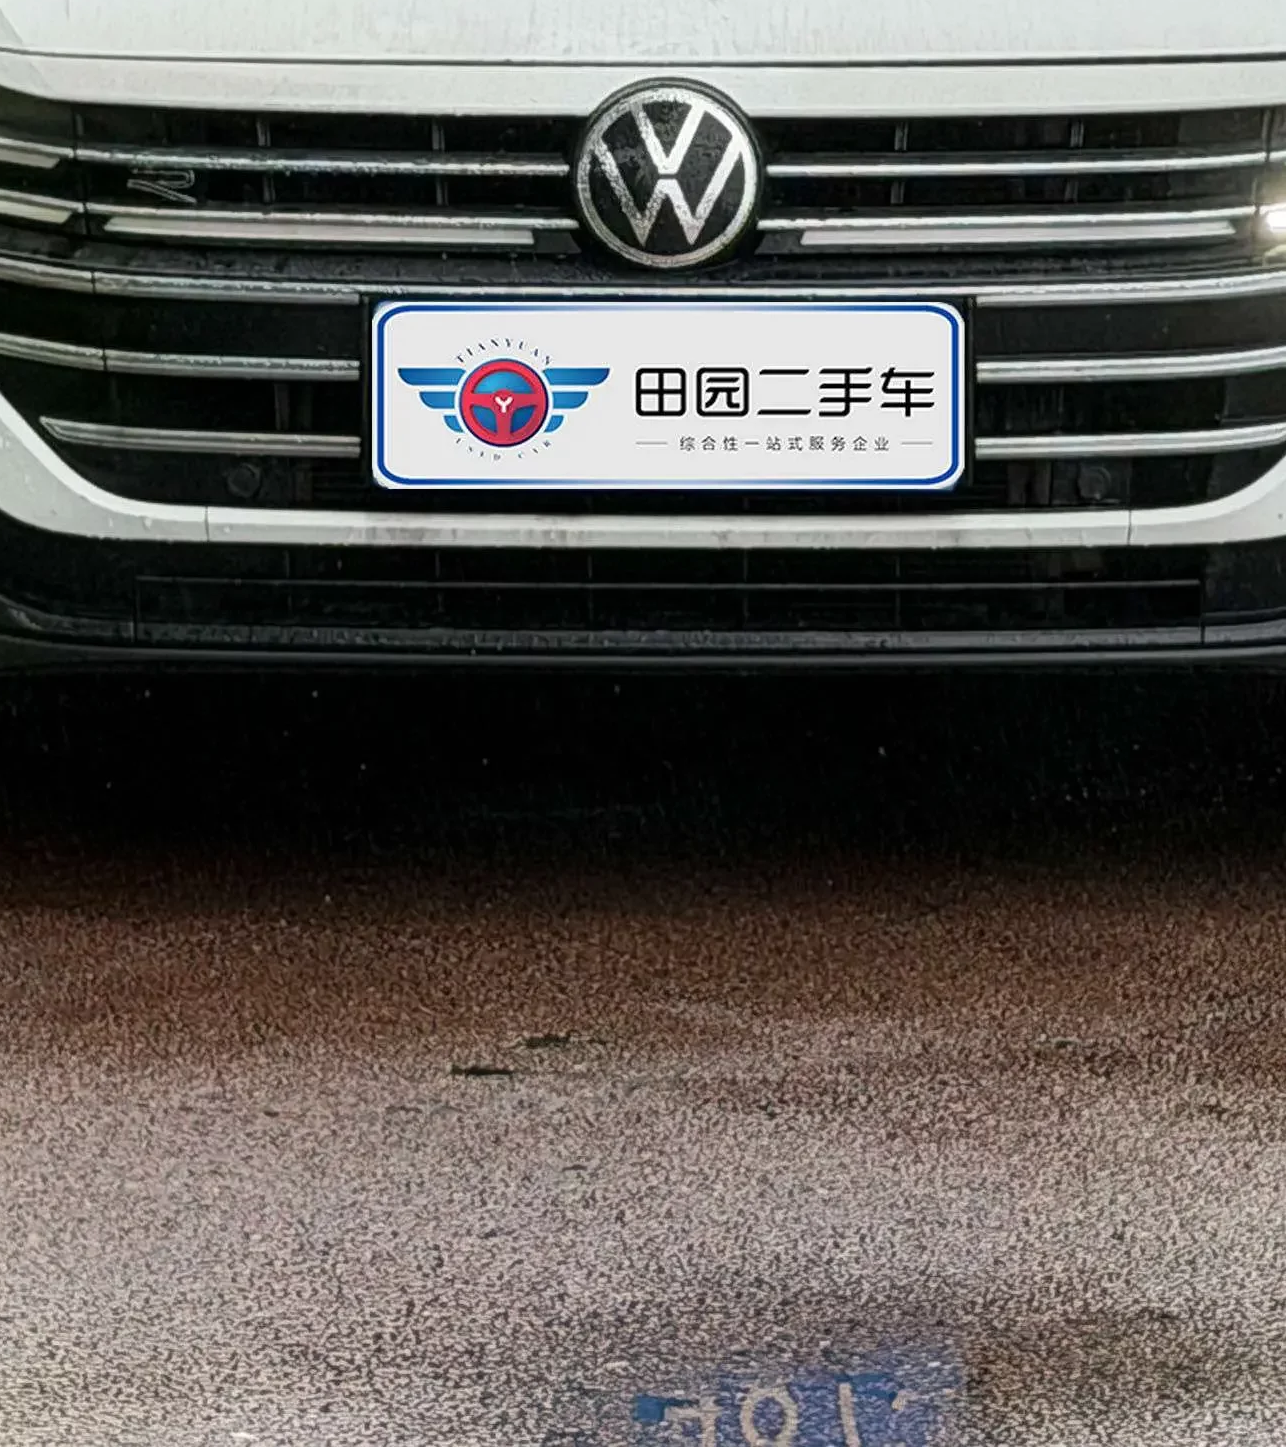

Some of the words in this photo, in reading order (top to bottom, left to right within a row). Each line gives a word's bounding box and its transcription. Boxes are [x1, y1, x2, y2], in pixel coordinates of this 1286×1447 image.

[635, 366, 935, 417] 田园二手车
[679, 435, 890, 452] 综合性一站式服务企业
